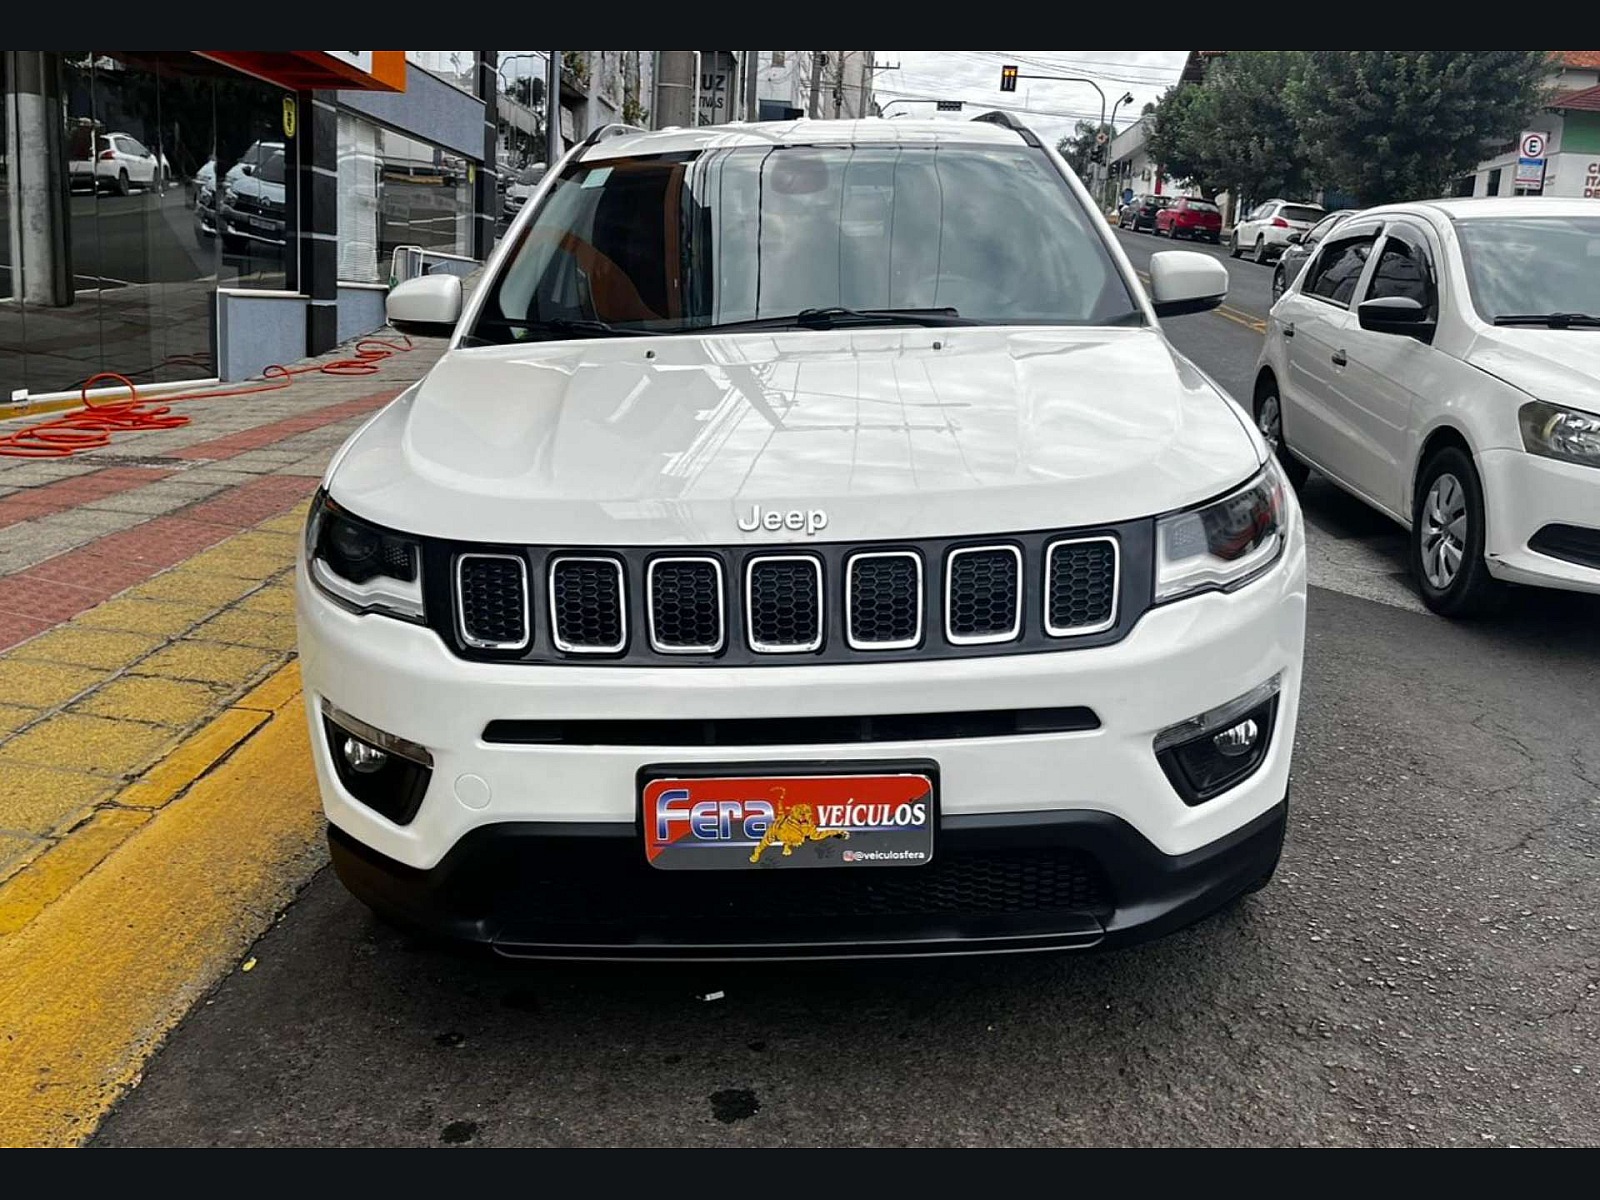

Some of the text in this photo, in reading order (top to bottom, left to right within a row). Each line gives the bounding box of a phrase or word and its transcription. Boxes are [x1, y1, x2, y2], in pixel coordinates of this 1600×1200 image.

[1529, 139, 1538, 153] E
[737, 504, 828, 536] Jeep
[816, 798, 926, 827] VEÍCULOS
